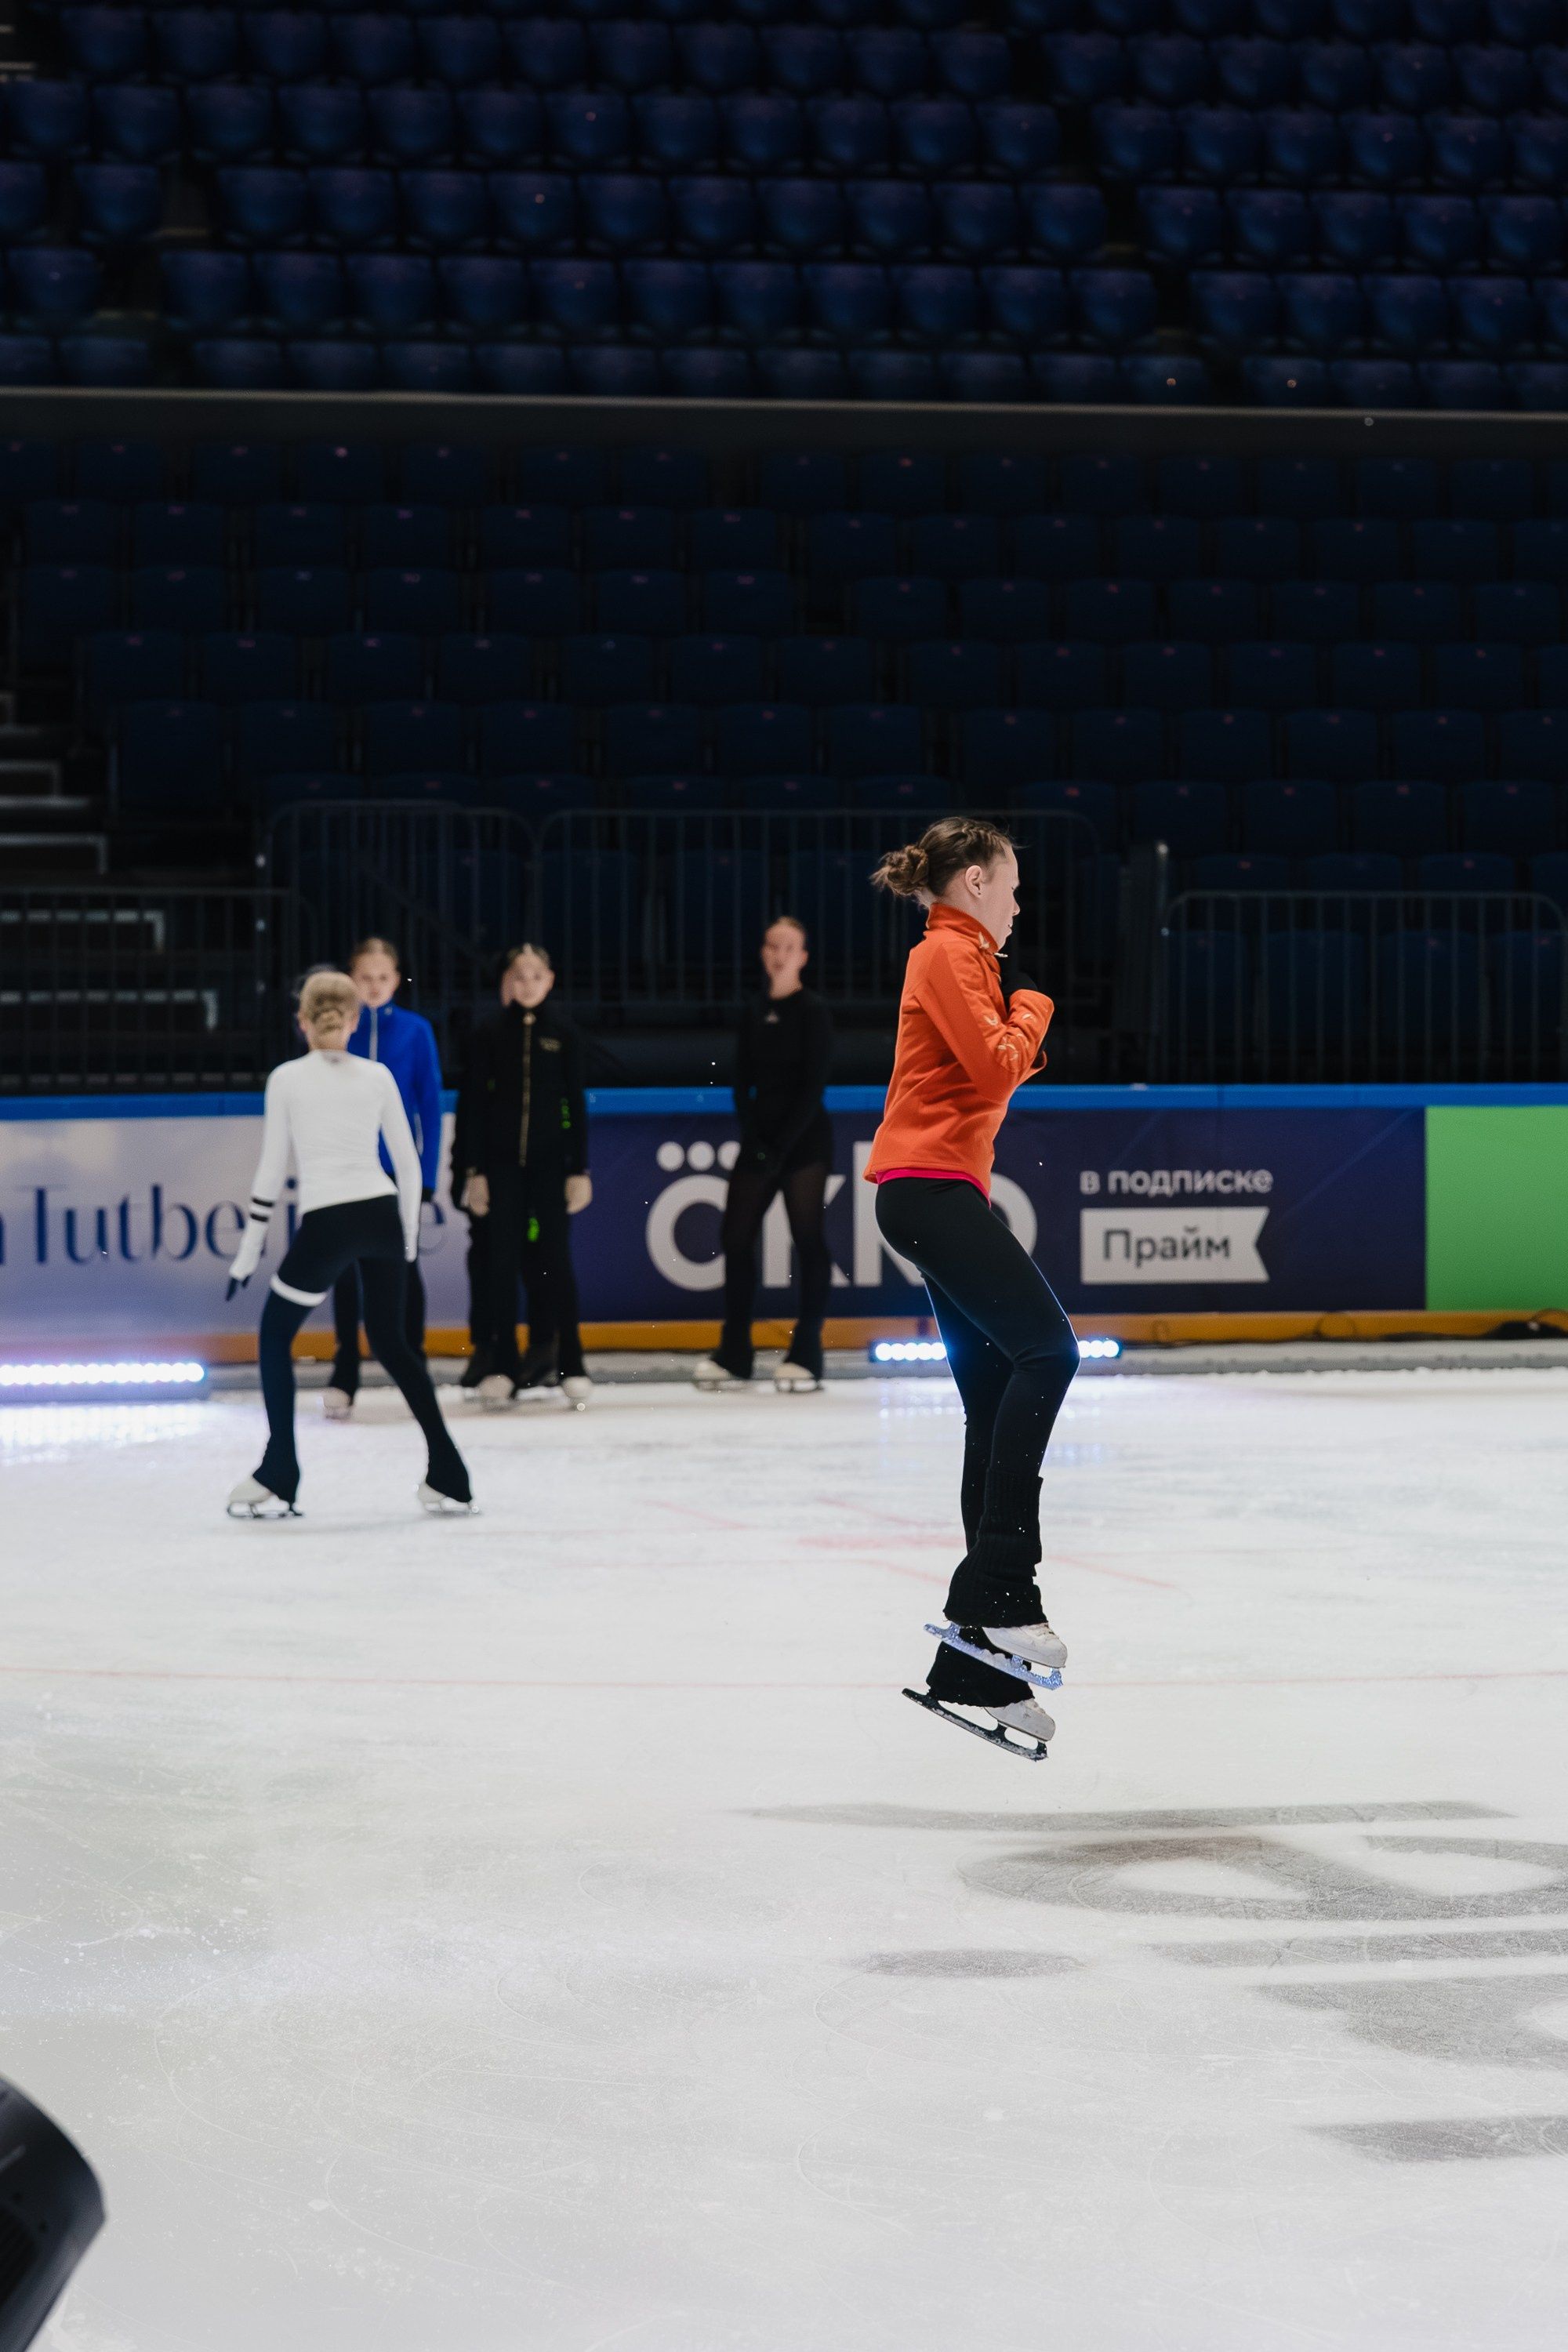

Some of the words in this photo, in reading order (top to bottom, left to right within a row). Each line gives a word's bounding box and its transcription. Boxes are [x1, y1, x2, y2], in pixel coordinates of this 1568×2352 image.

[1080, 1171, 1100, 1195] в
[1107, 1169, 1274, 1197] подписке
[13, 1176, 449, 1265] Tutbeie
[1103, 1225, 1231, 1269] Прайм
